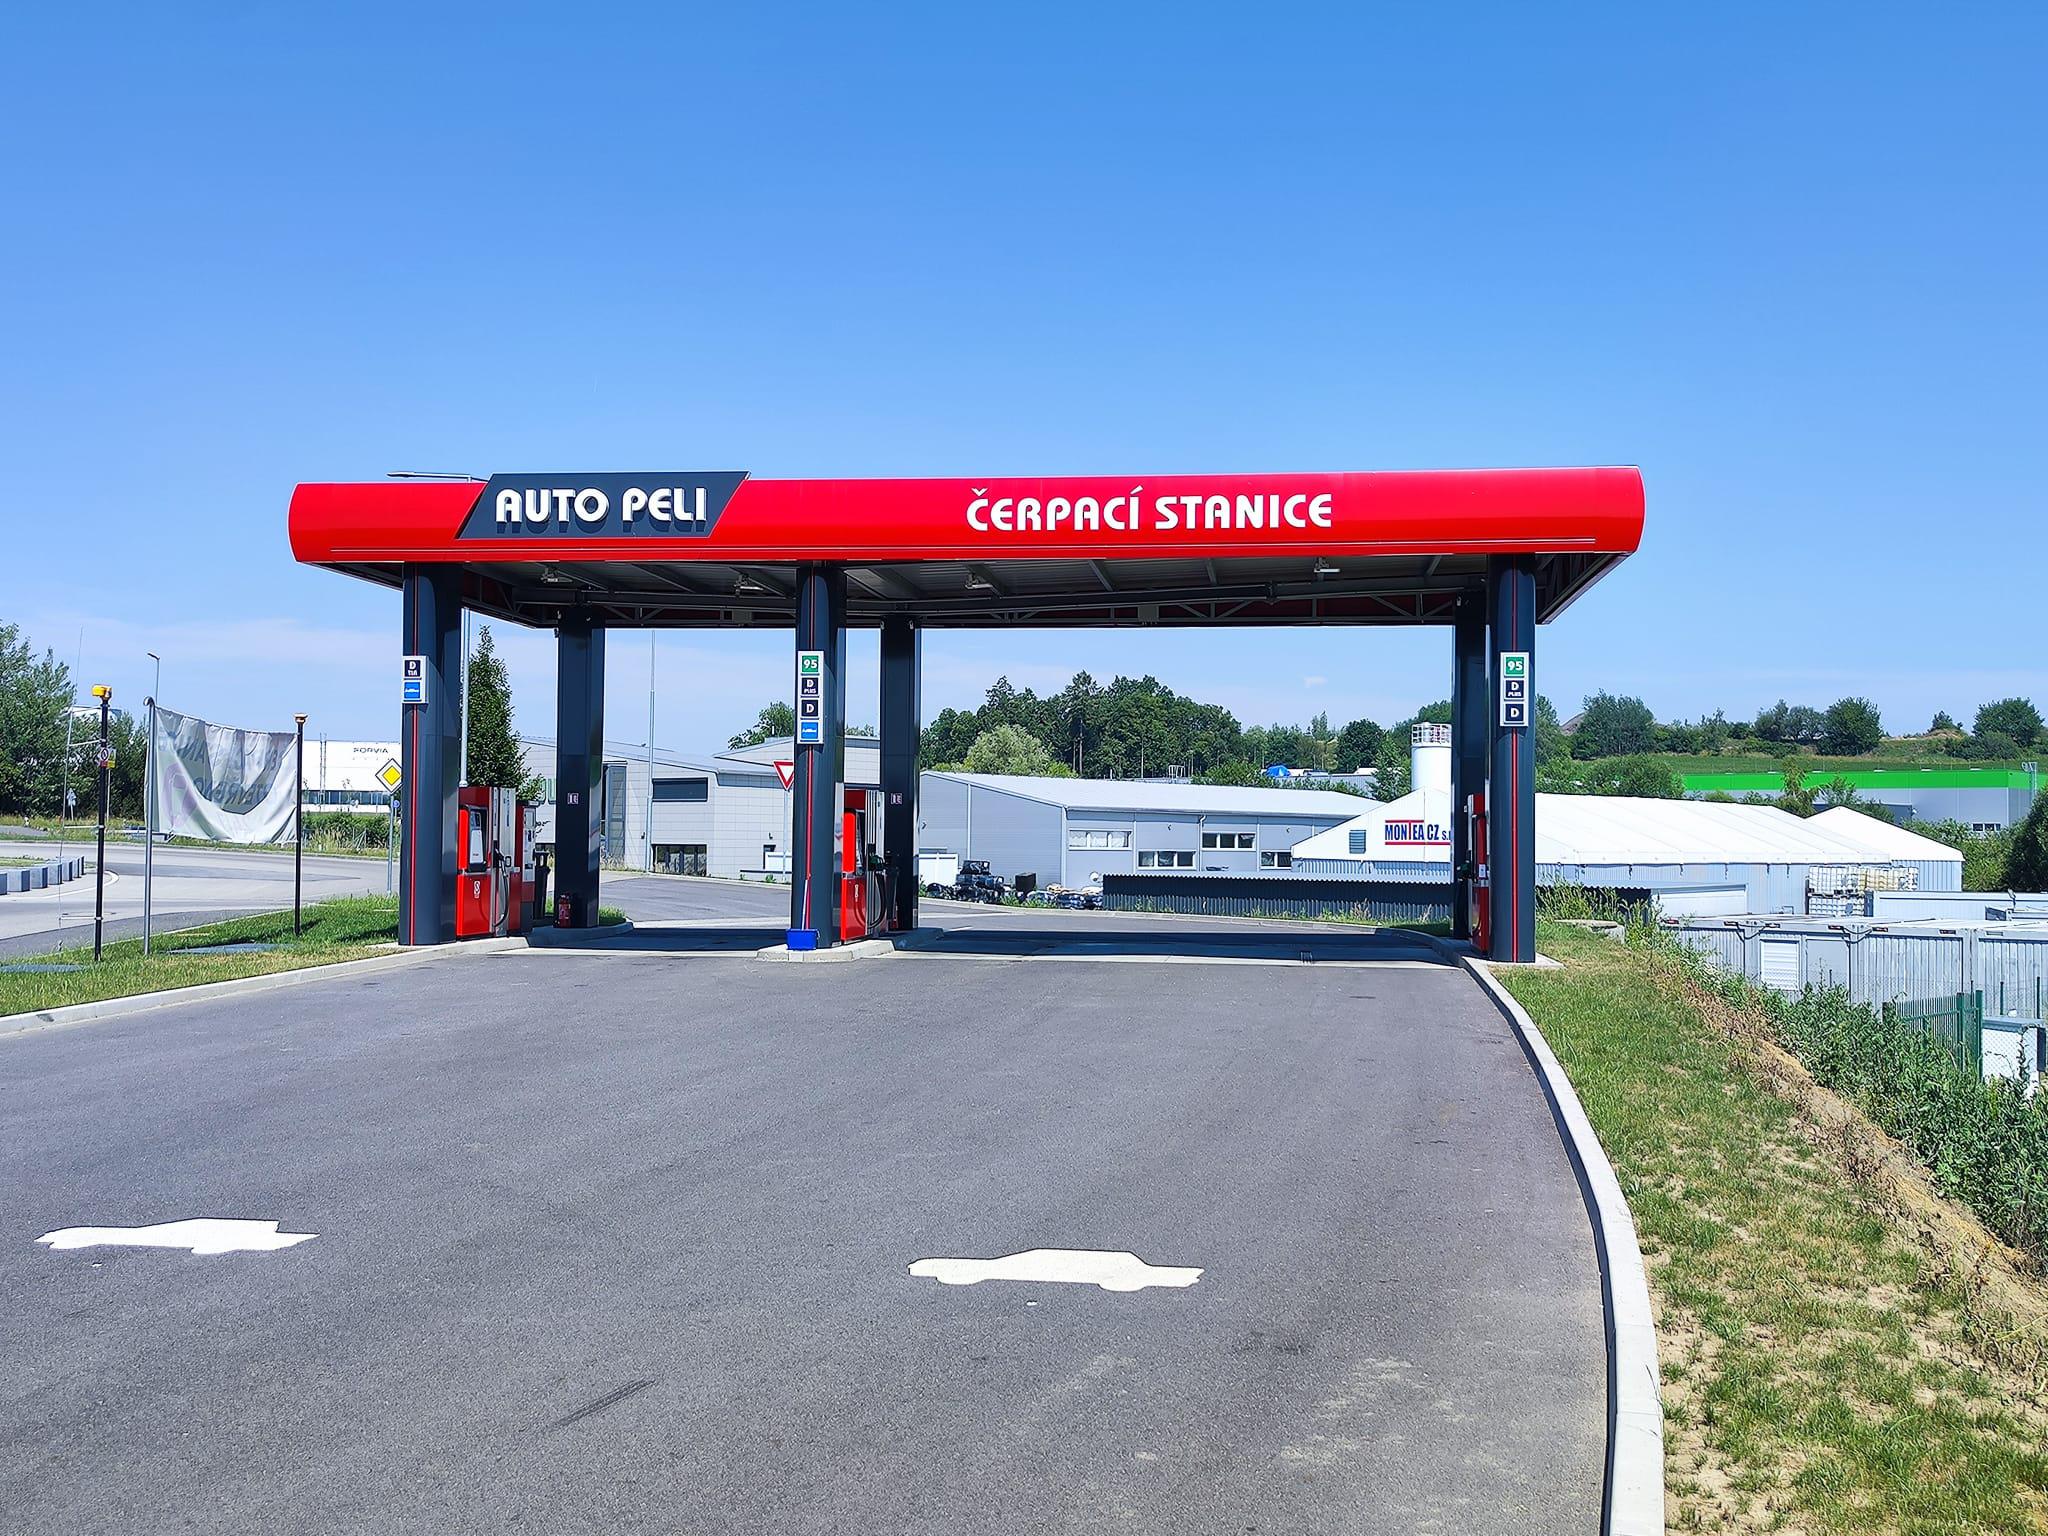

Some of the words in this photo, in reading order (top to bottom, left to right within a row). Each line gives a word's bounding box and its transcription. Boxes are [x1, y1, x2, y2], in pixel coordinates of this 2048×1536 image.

[496, 488, 609, 522] AUTO
[623, 488, 707, 522] PELI
[966, 486, 1143, 531] ČERPACÍ
[1154, 493, 1333, 529] STANICE
[409, 661, 416, 670] D
[804, 659, 818, 668] 95
[1508, 661, 1522, 670] 95
[806, 680, 814, 688] D
[1512, 682, 1519, 690] D
[806, 704, 814, 714] D
[1510, 708, 1520, 718] D
[1384, 821, 1424, 840] MONTEA
[1427, 824, 1440, 840] CZ
